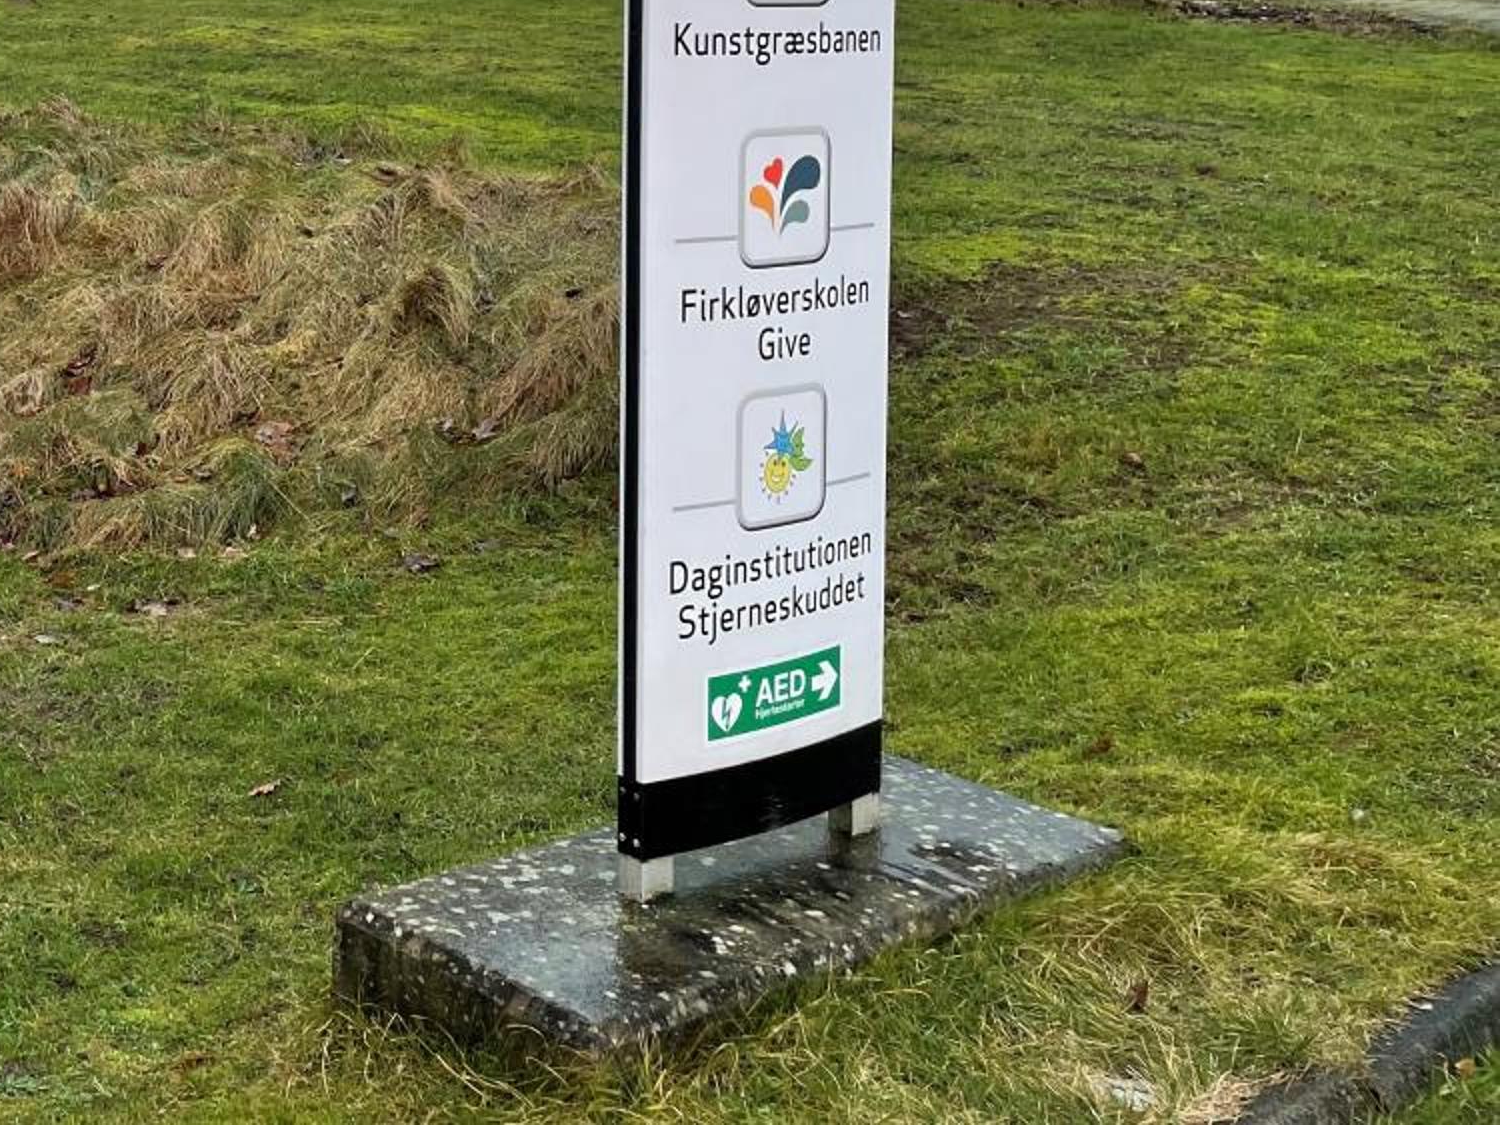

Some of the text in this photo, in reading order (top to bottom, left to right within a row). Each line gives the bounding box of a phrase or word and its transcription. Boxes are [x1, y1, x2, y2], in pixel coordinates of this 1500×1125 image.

[674, 20, 881, 65] Kunstgræsbanen
[680, 274, 870, 323] Firkløverskolen
[757, 326, 811, 361] Give
[669, 531, 872, 599] Daginstitutionen
[678, 572, 865, 646] Stjerneskuddet
[755, 668, 807, 708] AED
